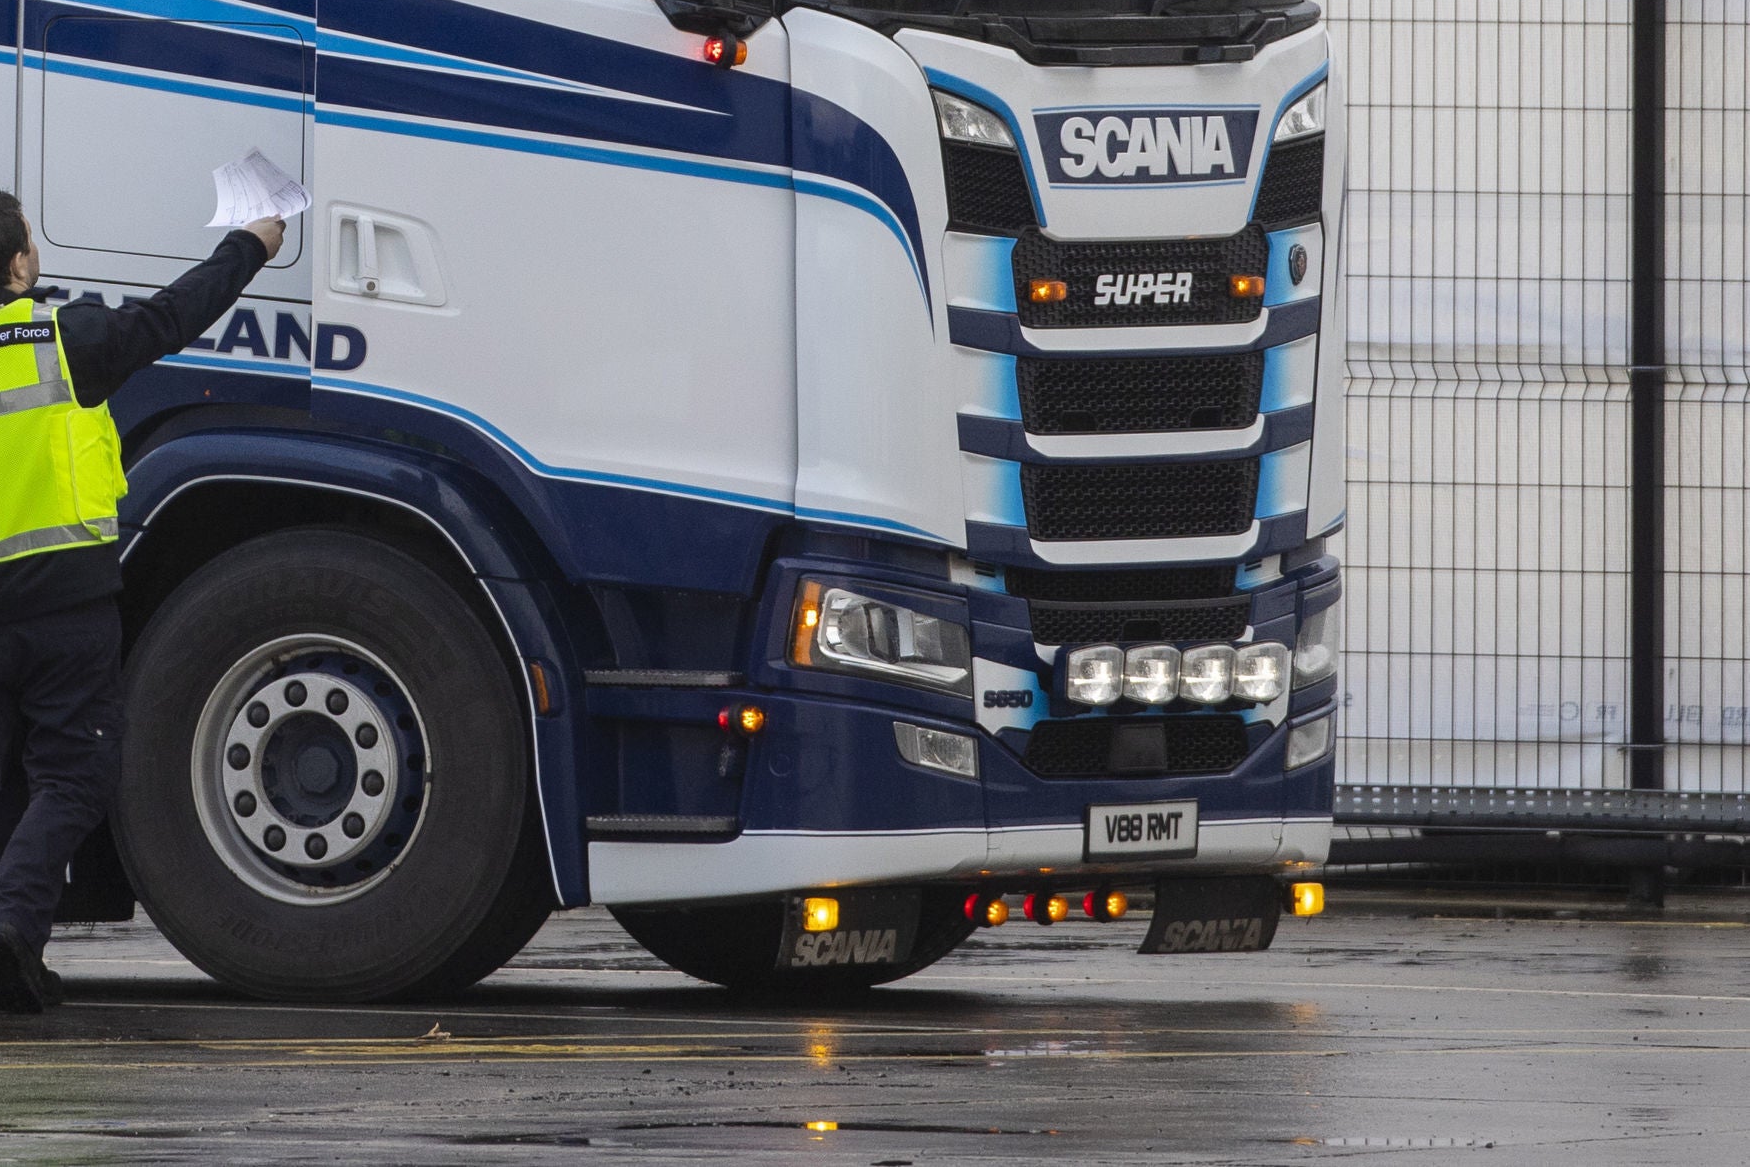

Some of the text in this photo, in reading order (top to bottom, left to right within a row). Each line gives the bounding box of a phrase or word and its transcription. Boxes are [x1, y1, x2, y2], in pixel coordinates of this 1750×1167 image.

[1059, 116, 1235, 178] SCANIA
[1094, 272, 1193, 306] SUPER
[14, 327, 50, 339] Force
[983, 689, 1033, 708] S650
[1105, 811, 1183, 843] V88 RMT
[791, 929, 896, 966] SCANIA
[1157, 917, 1262, 952] SCANIA
